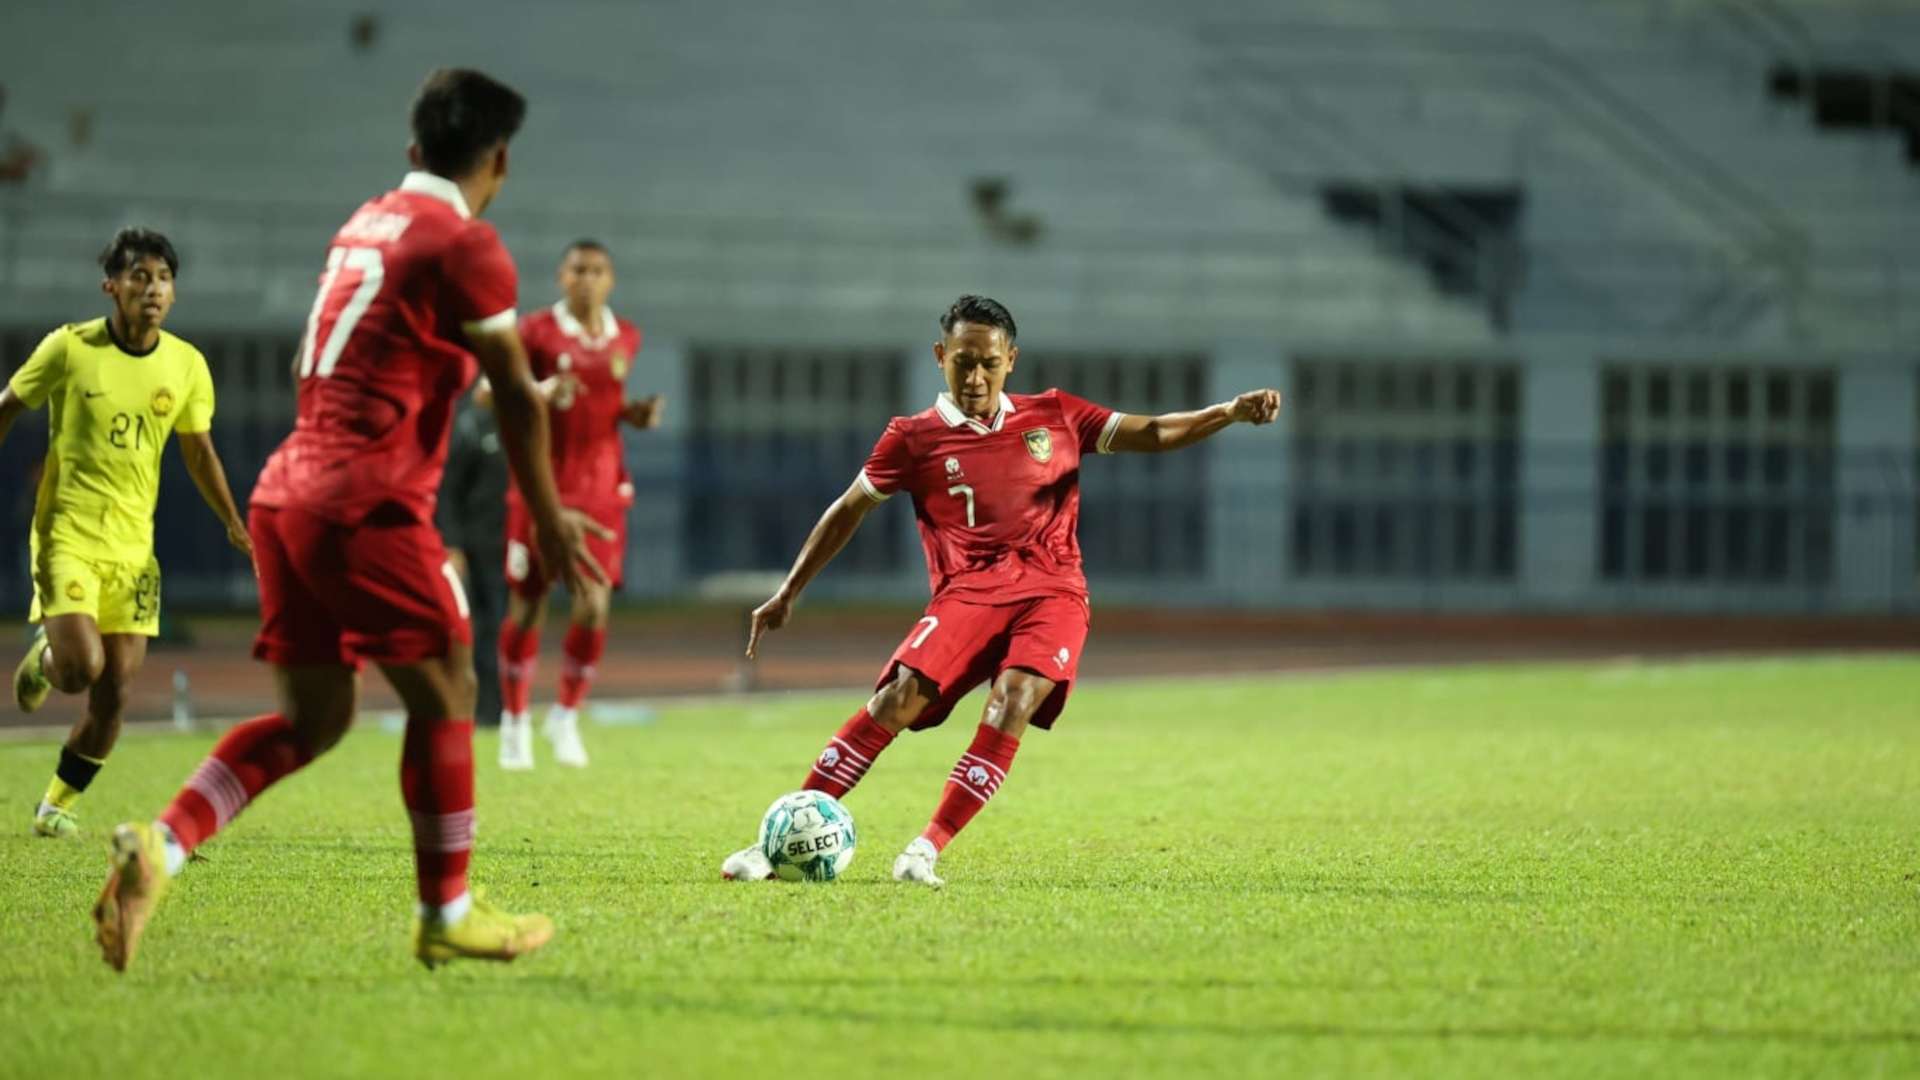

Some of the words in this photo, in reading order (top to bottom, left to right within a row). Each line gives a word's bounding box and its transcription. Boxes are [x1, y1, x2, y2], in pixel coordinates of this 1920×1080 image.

[300, 246, 385, 379] 17
[111, 412, 144, 451] 21
[948, 484, 976, 528] 7
[911, 615, 939, 649] 7
[787, 832, 839, 857] SELECT
